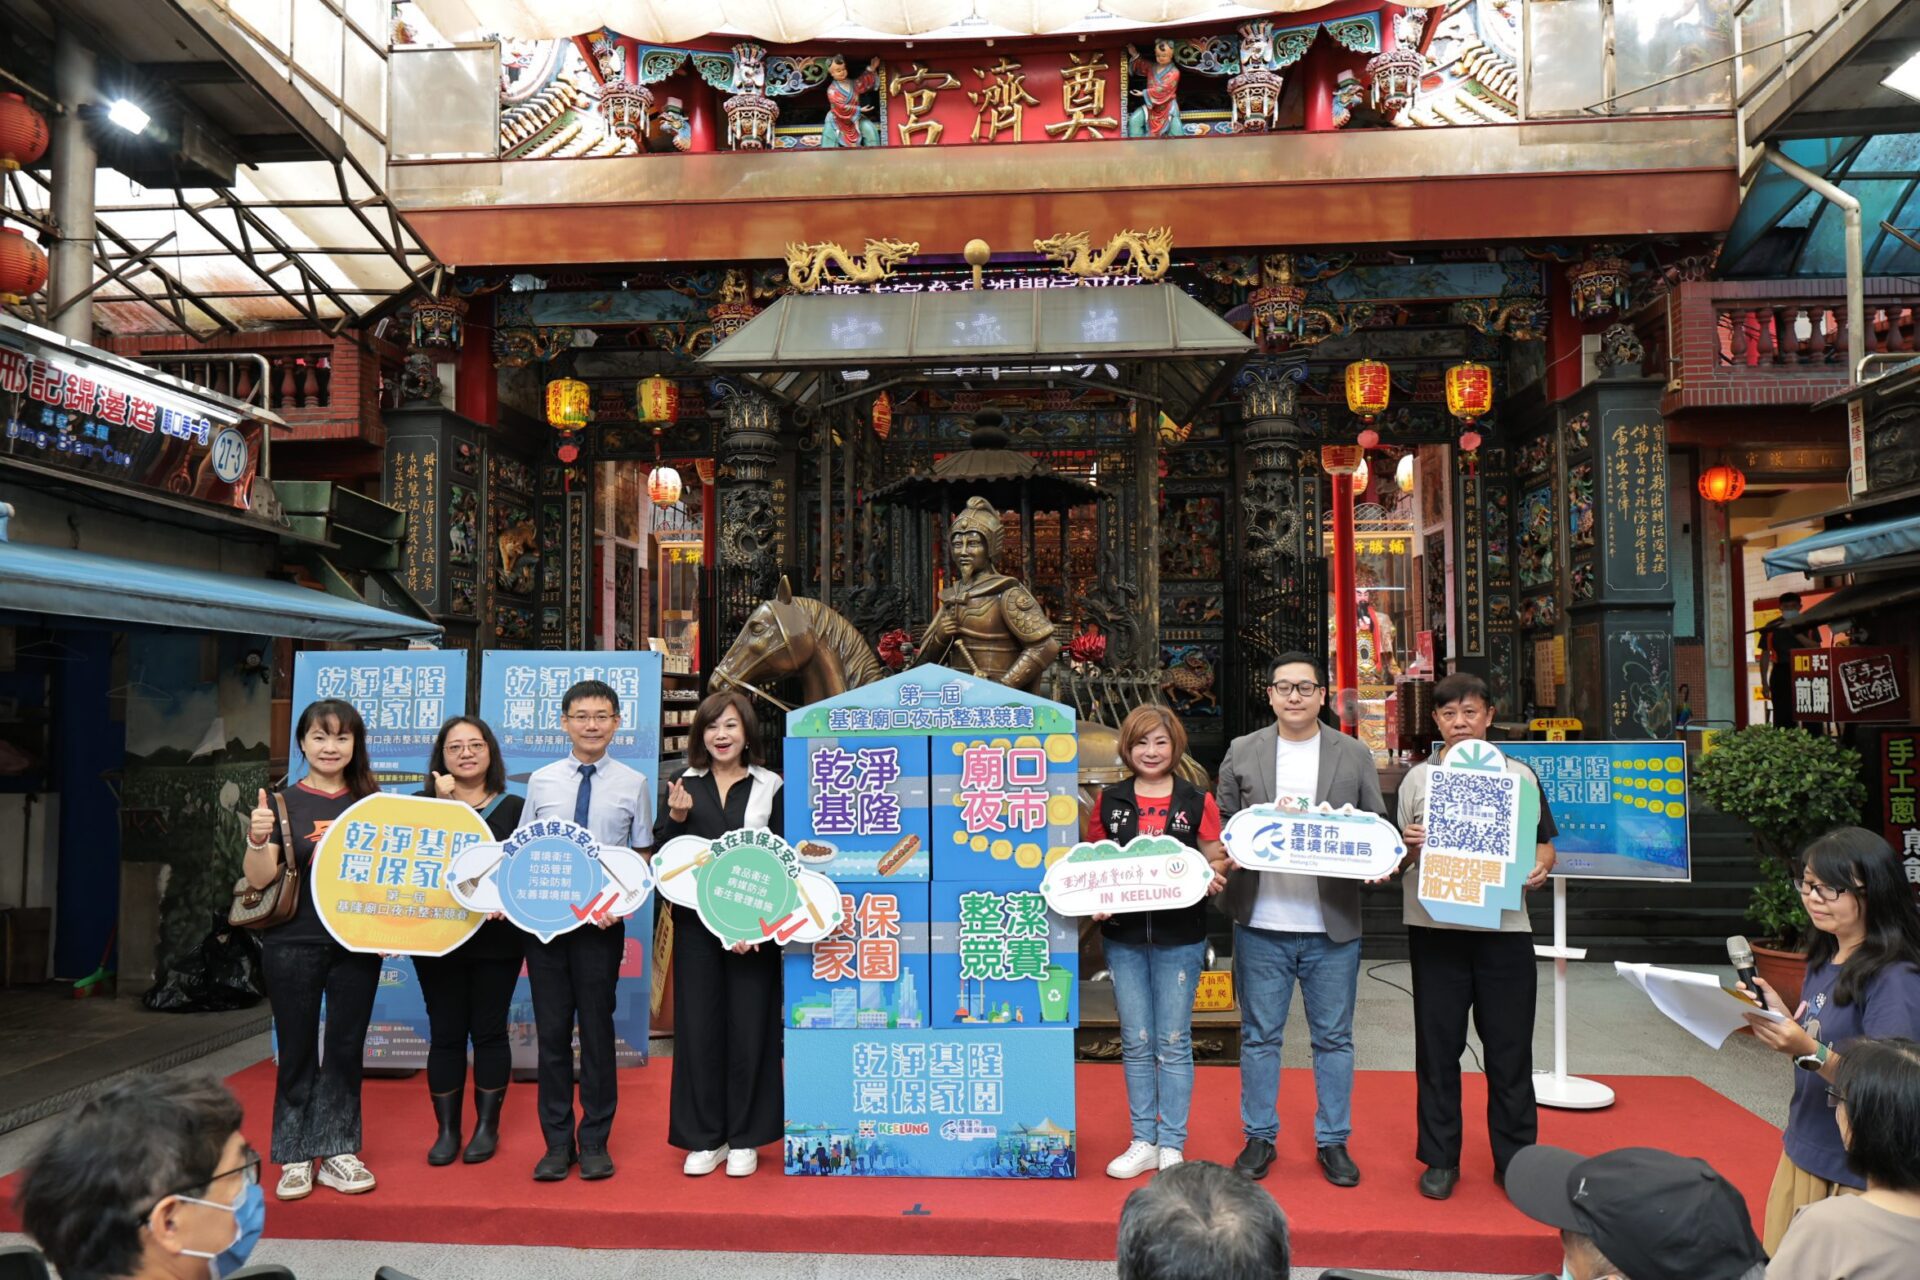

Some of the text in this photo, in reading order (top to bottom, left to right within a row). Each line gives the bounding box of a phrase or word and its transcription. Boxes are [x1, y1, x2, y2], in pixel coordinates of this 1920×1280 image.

[216, 438, 243, 474] 27-3
[1331, 539, 1405, 555] 輔勝將
[1812, 654, 1828, 672] 手工
[316, 666, 445, 697] 乾淨基隆
[900, 685, 961, 706] 第一屆
[1795, 677, 1829, 714] 煎餅
[503, 698, 638, 731] 環保
[829, 708, 1034, 730] 基隆廟口夜市整潔競賽
[813, 748, 899, 792] 乾淨
[961, 745, 1048, 788] 廟口
[1514, 756, 1610, 780] 淨基隆
[813, 793, 900, 835] 基隆
[961, 789, 1049, 833] 夜市
[503, 821, 601, 859] 食在環保又安心
[1291, 823, 1339, 839] 基隆市
[530, 851, 573, 863] 環境衛生
[710, 830, 802, 880] 食在環保又安心
[1290, 838, 1373, 857] 環境保護局
[338, 853, 450, 889] 環保家
[528, 876, 572, 888] 污染防制
[529, 864, 573, 875] 垃圾管理
[731, 864, 772, 885] 食品衛生
[1424, 852, 1501, 885] 網路投票
[386, 889, 427, 904] 第一屆
[517, 889, 582, 901] 友善環境措施
[713, 887, 775, 914] 衛生管理措施
[727, 877, 768, 897] 病媒防治
[1100, 886, 1182, 904] IN KEELUNG
[1422, 876, 1481, 904] 抽大獎
[336, 899, 470, 921] 基隆廟口夜市整潔競賽
[960, 891, 1048, 937] 整潔
[812, 938, 899, 982] 家園
[960, 937, 1049, 980] 競賽
[854, 1043, 1003, 1077] 乾淨基隆
[854, 1080, 1003, 1114] 環保家園
[878, 1122, 929, 1137] KEELUNG
